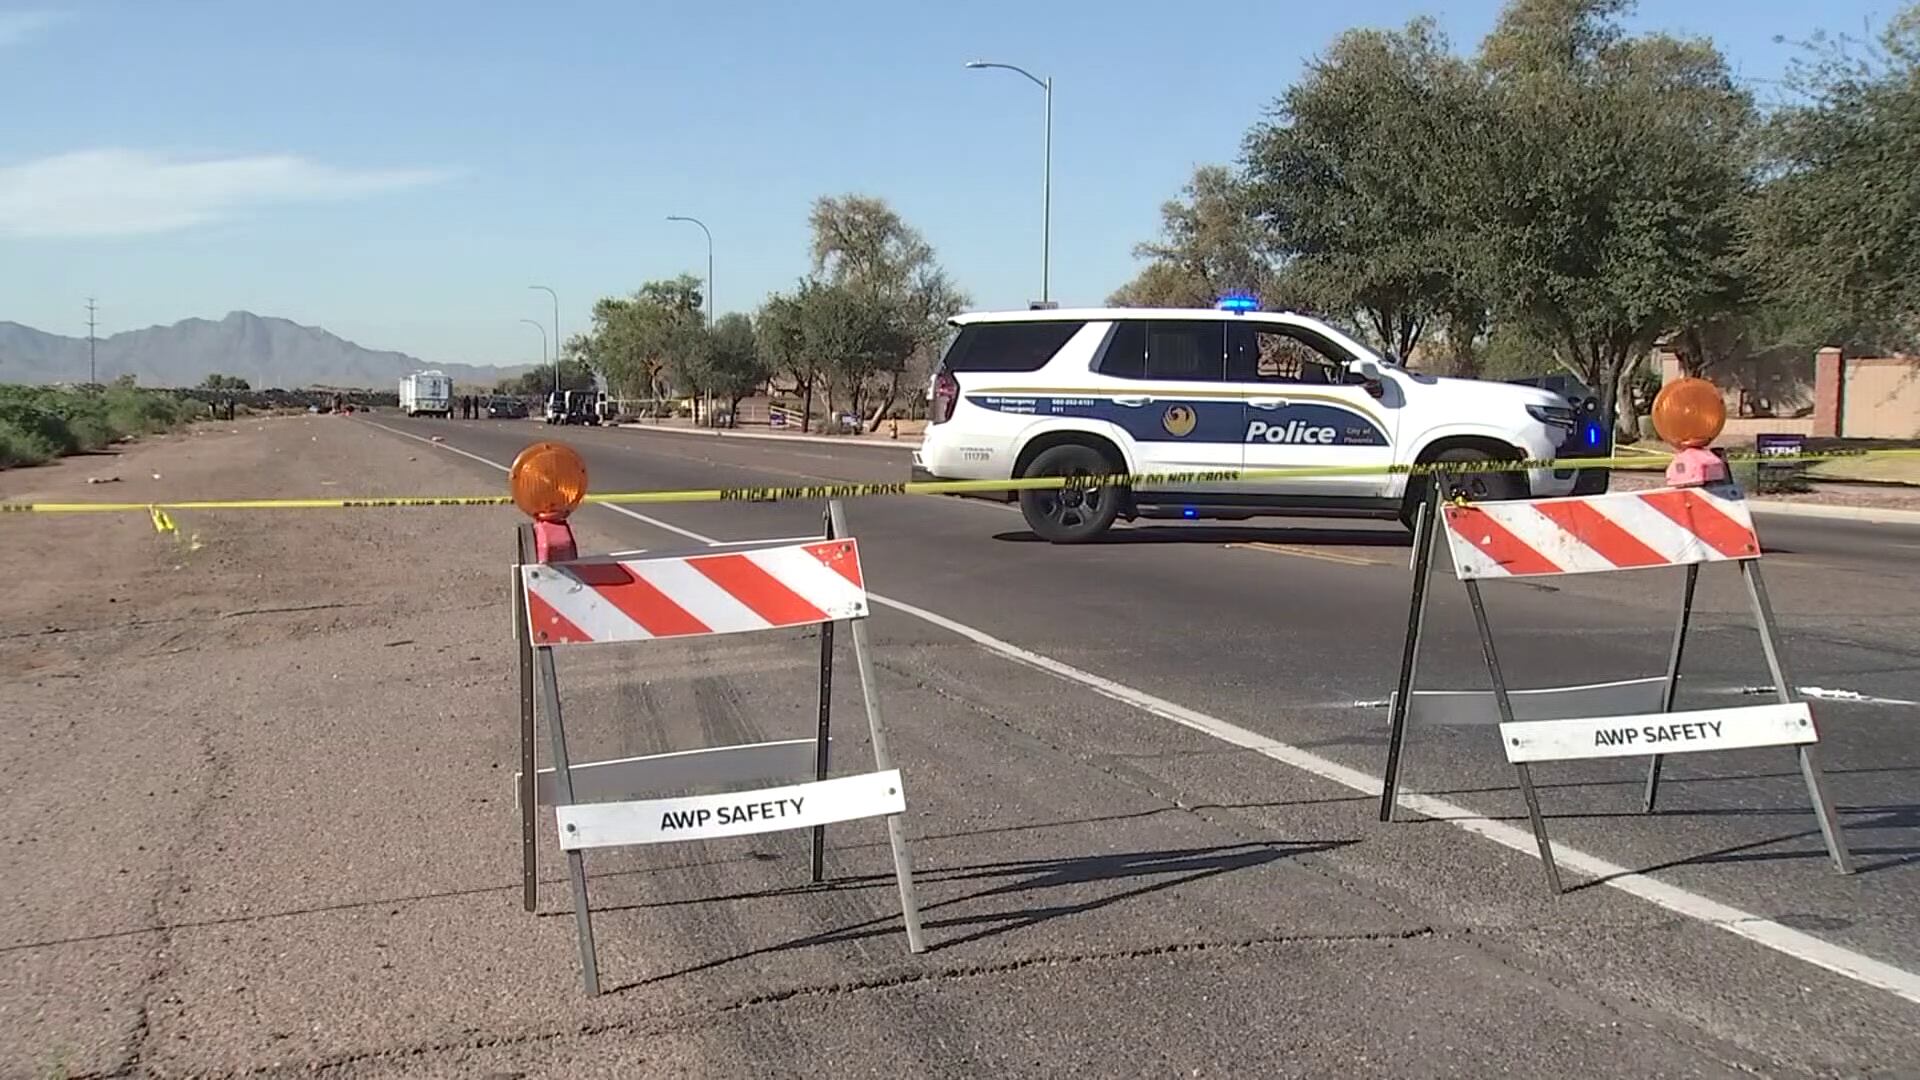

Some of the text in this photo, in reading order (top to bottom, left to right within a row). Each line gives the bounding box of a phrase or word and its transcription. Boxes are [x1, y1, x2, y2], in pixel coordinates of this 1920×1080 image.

[1001, 397, 1036, 405] Emergency
[1001, 405, 1036, 413] Emergency
[1246, 420, 1336, 443] Police
[1064, 475, 1110, 488] POLICE
[1146, 473, 1163, 485] DO
[1168, 473, 1194, 483] NOT
[1197, 471, 1240, 482] CROSS
[720, 483, 906, 500] POLICE LINE DO NOT CROSS
[1595, 721, 1722, 746] AWP SAFETY
[661, 797, 804, 831] AWP SAFETY
